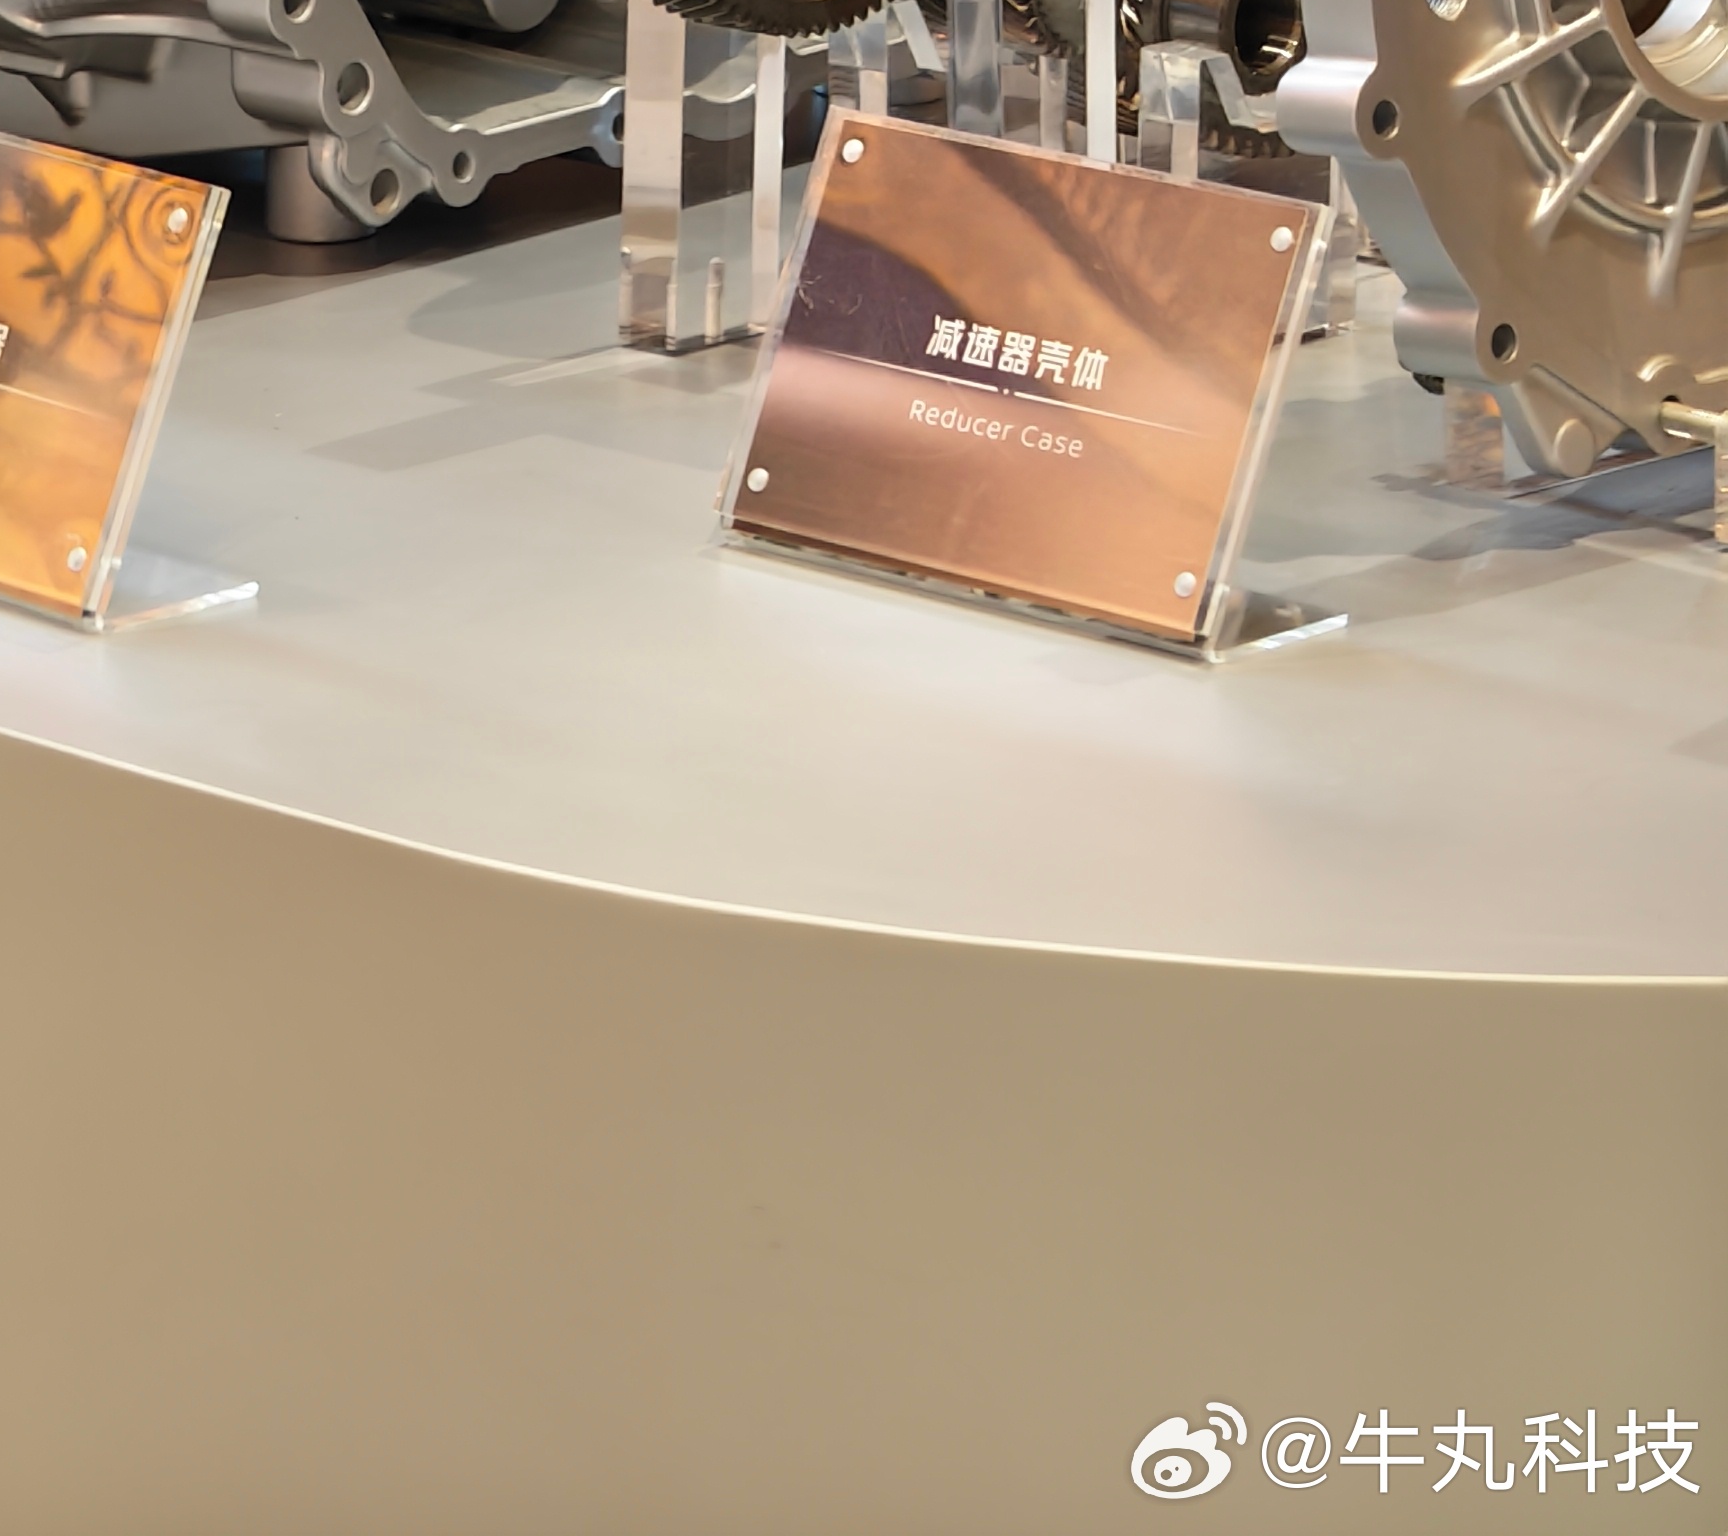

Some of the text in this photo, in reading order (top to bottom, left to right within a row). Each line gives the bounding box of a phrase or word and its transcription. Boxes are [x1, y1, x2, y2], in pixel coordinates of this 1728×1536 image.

[925, 314, 1111, 393] 减速器壳体
[908, 398, 1085, 460] Reducer Case
